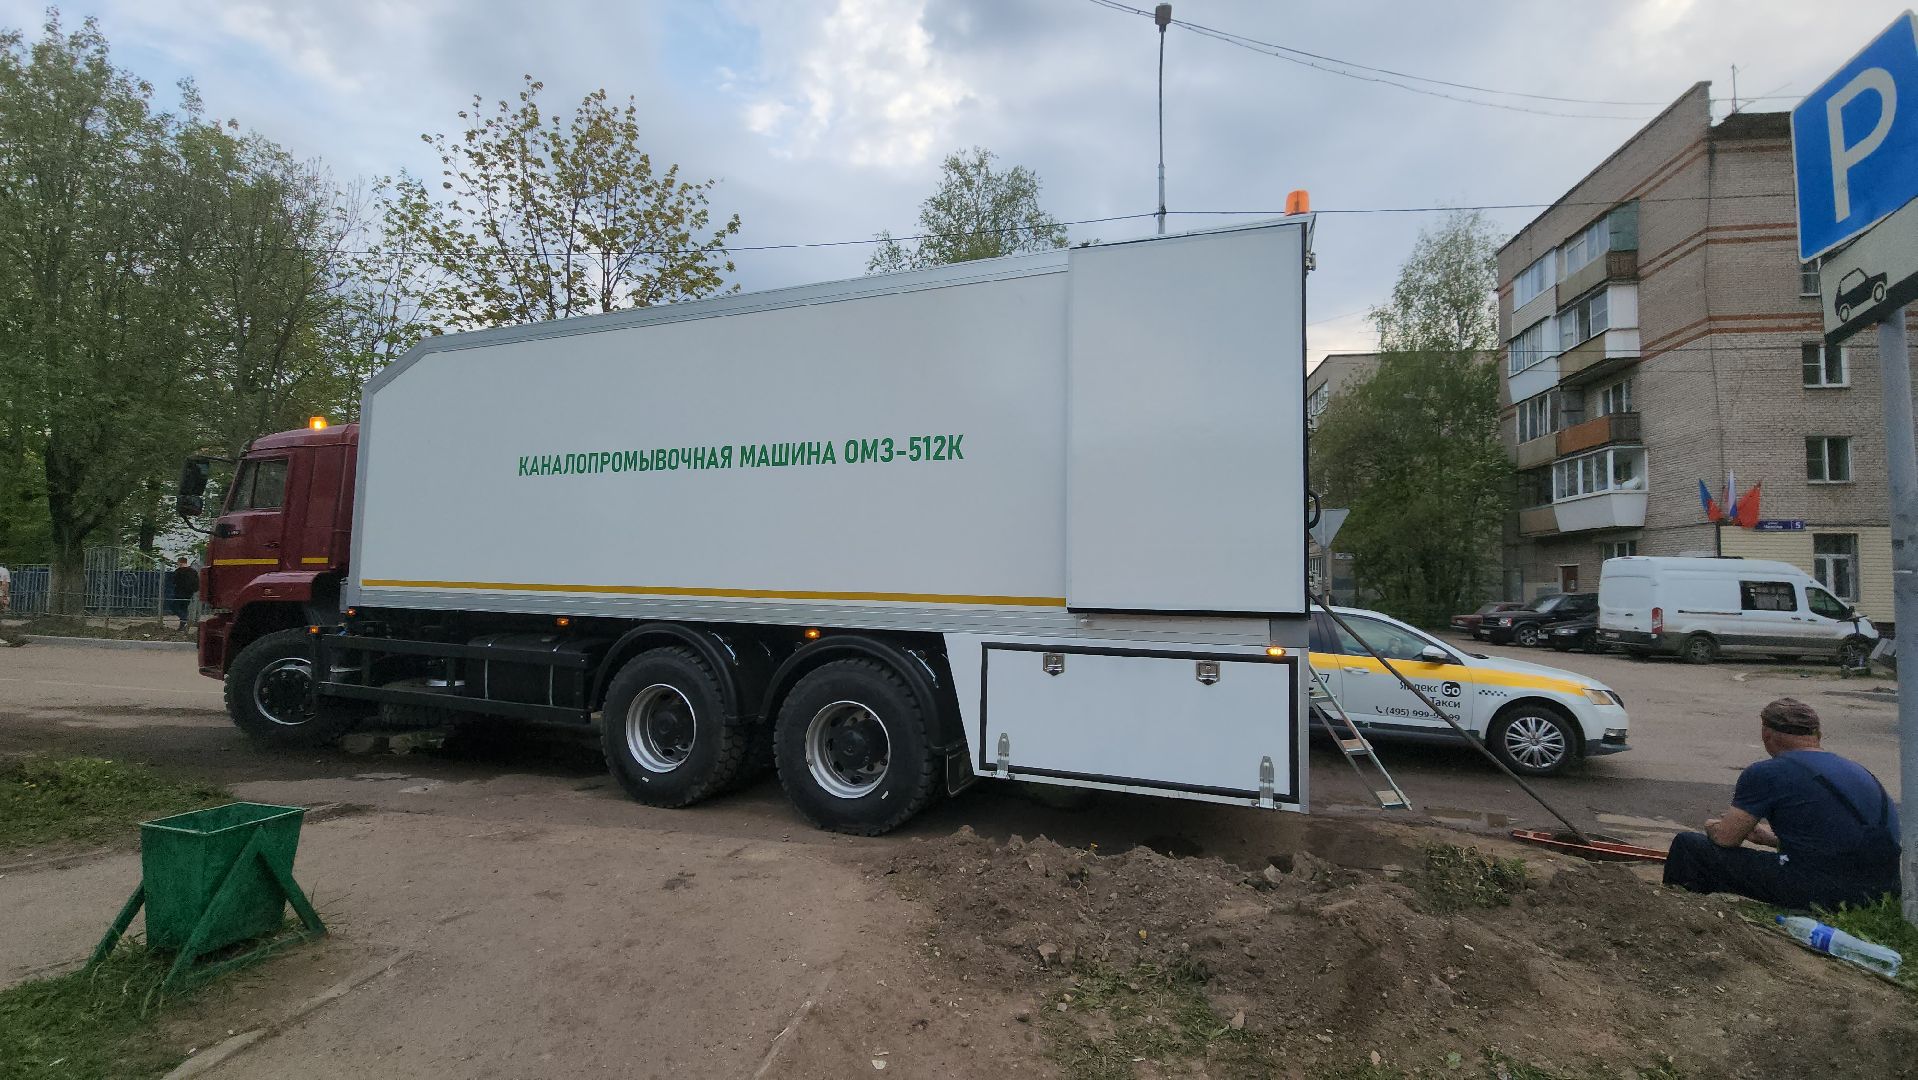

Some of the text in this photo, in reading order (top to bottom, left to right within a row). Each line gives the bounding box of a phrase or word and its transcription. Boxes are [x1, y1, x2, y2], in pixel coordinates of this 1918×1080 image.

[518, 445, 734, 477] КАНАЛОПРОМЫВОЧНАЯ
[739, 440, 837, 468] МАШИНА
[1442, 682, 1460, 696] Go
[1430, 696, 1461, 708] Такси
[1385, 706, 1410, 717] (495)
